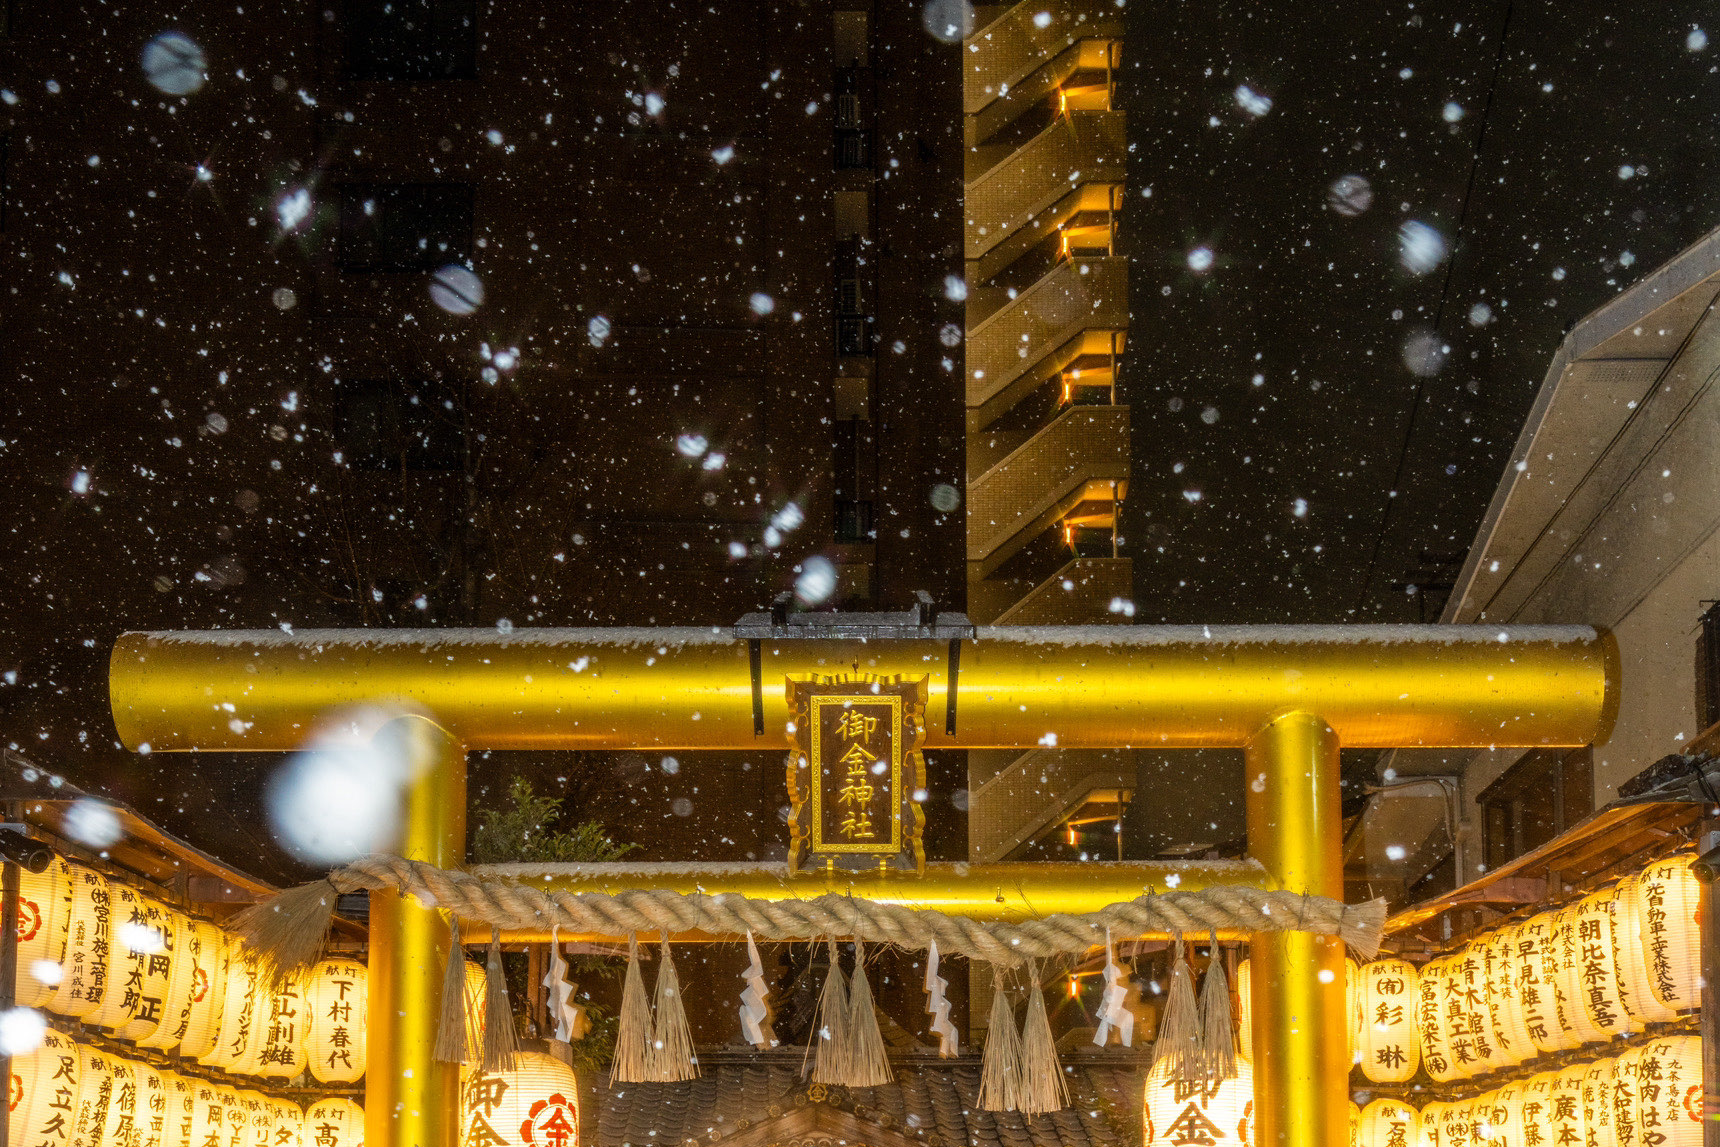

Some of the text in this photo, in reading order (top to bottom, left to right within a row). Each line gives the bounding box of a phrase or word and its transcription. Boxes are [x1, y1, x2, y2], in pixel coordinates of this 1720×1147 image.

[834, 709, 878, 839] 御金神社
[325, 965, 358, 979] 献灯
[1372, 964, 1405, 975] 献灯
[1560, 923, 1576, 970] 株式会社
[1578, 920, 1618, 1029] 朝比奈真吾
[1646, 883, 1681, 1003] 光自動車工業株式会社
[326, 979, 353, 1070] 下村春代
[1373, 977, 1408, 1070] (有)彩琳
[1445, 977, 1478, 1065] 大真工業
[1516, 940, 1548, 1044] 早見雄二郎
[312, 1108, 345, 1121] 献灯
